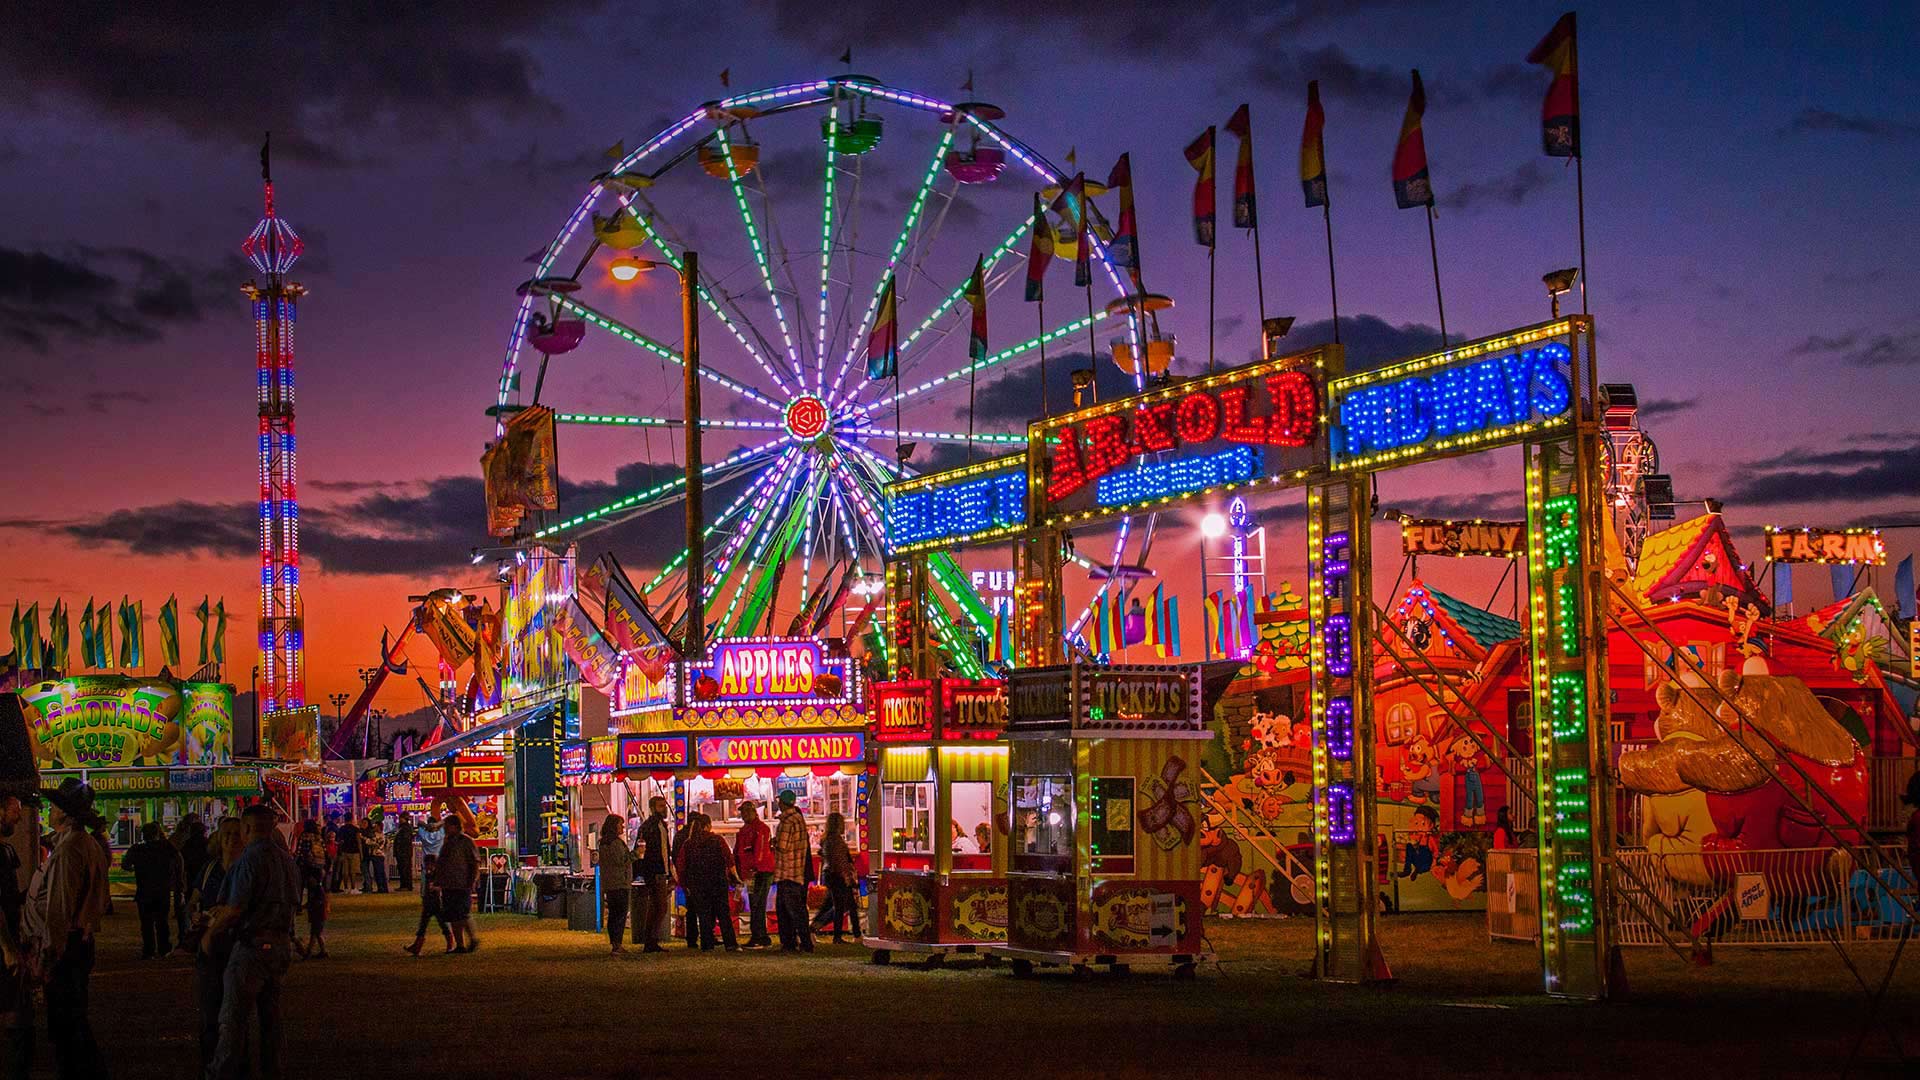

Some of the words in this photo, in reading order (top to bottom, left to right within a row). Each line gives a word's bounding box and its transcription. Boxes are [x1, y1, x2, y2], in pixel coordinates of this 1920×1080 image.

[1345, 342, 1571, 455] MIDWAYS
[1046, 371, 1320, 501] ARNOLD
[1406, 524, 1521, 552] FUNNY
[1770, 533, 1877, 560] FARM
[719, 648, 813, 695] APPLES
[1095, 679, 1182, 715] TICKETS
[1323, 533, 1355, 845] FOOD
[34, 700, 168, 746] LEMONADE
[1543, 497, 1595, 935] RIDES
[72, 732, 126, 750] CORN
[639, 742, 670, 753] COLD
[727, 739, 793, 761] COTTON
[797, 736, 854, 759] CANDY
[76, 748, 123, 763] DOGS
[628, 752, 682, 765] DRINKS
[92, 777, 123, 791] CORN
[129, 776, 161, 790] DOGS
[458, 769, 504, 784] PRET
